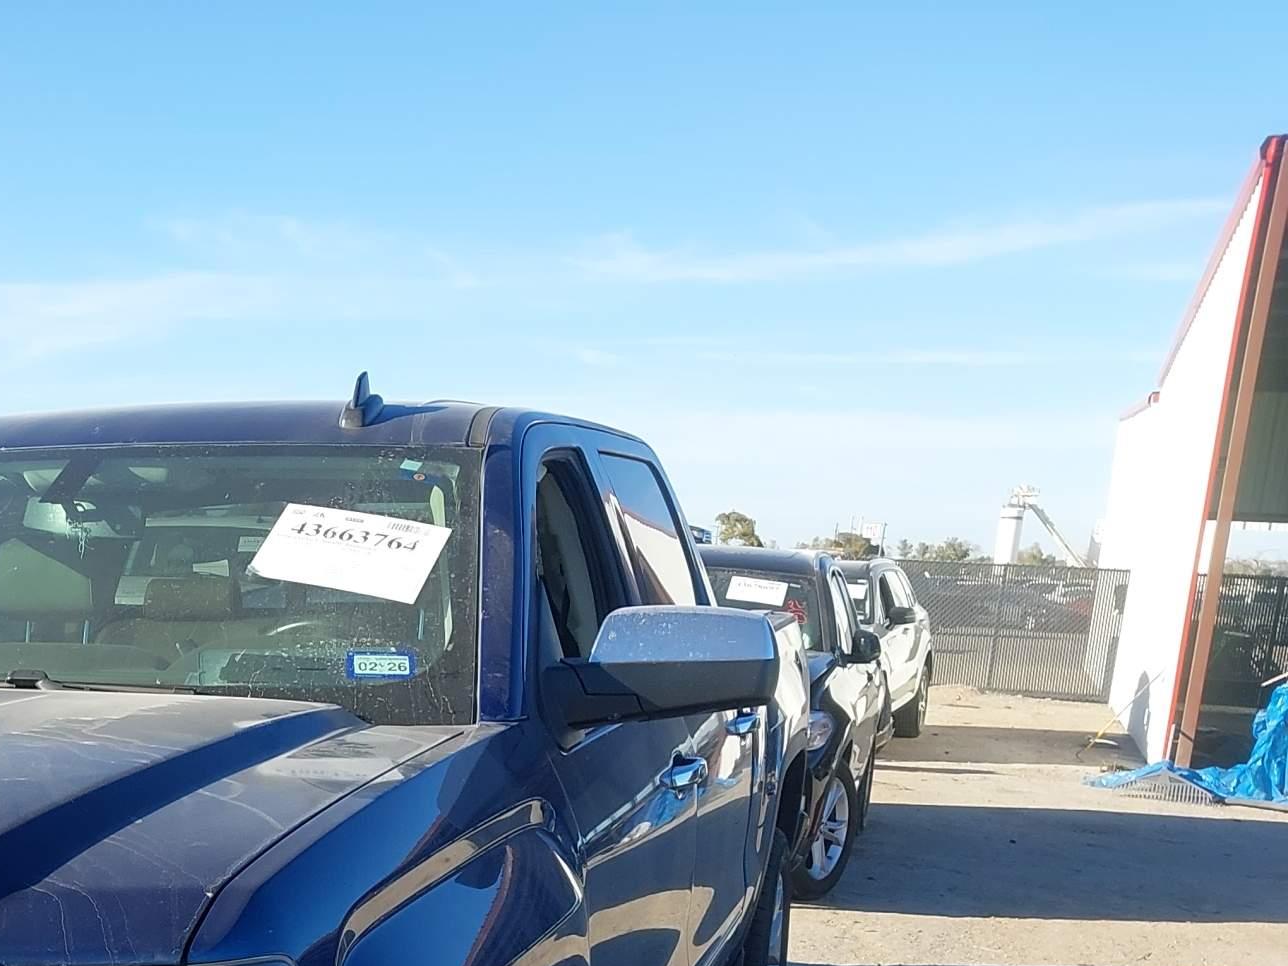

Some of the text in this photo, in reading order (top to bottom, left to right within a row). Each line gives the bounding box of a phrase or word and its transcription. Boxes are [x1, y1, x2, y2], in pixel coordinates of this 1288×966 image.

[291, 521, 420, 551] 43663764
[358, 661, 408, 672] 02 26
